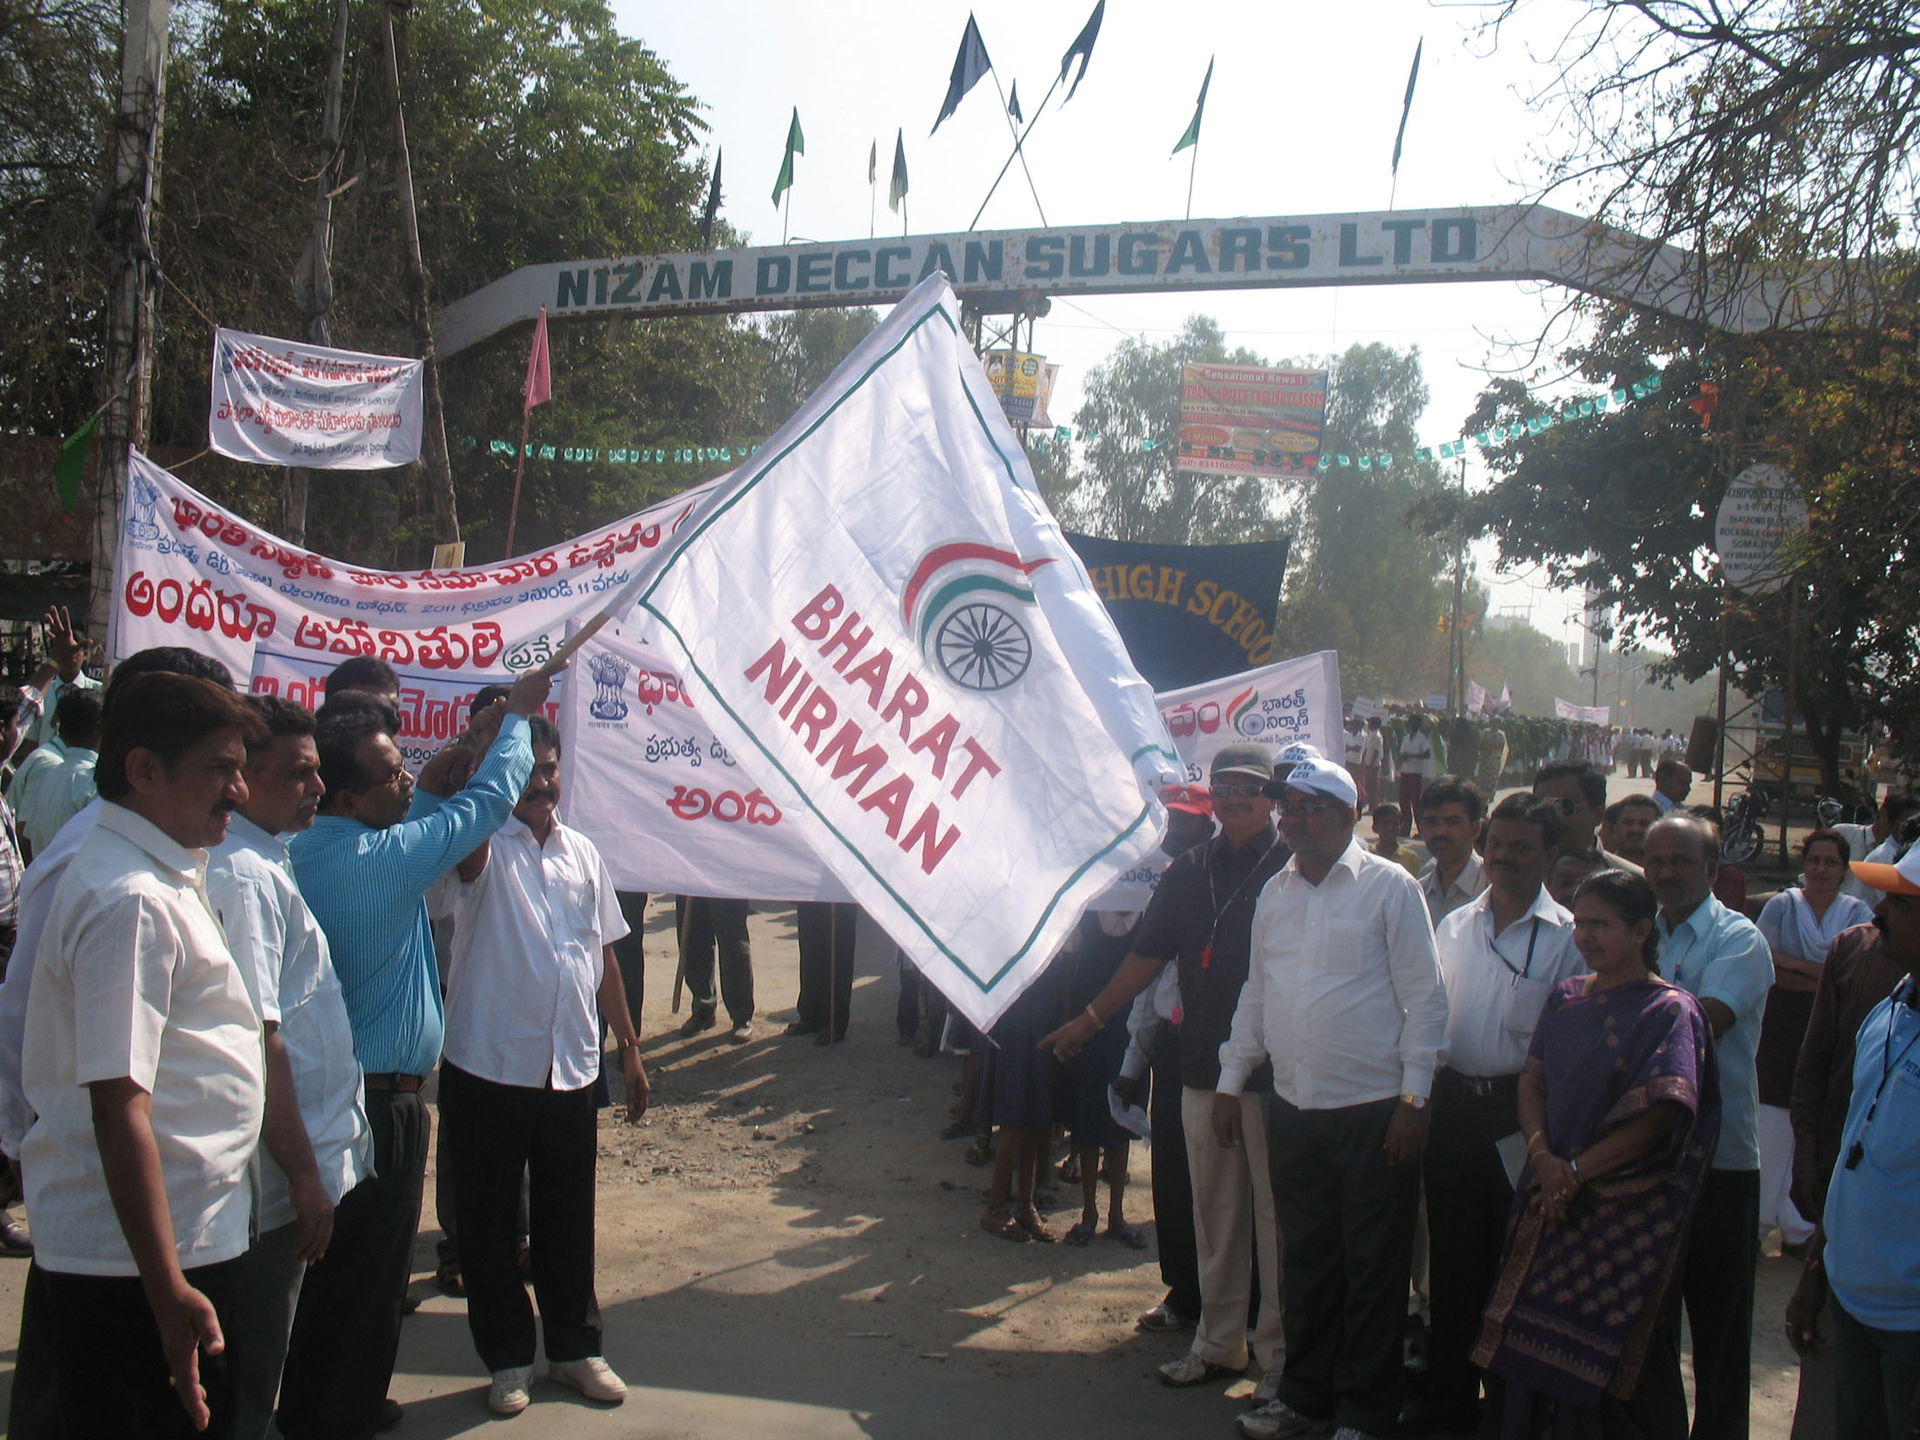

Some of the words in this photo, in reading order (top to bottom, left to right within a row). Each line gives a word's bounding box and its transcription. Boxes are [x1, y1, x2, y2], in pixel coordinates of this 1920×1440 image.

[557, 259, 733, 308] NIZAM
[755, 240, 1004, 297] DECCAN
[1024, 225, 1311, 279] SUGARS
[1338, 217, 1477, 268] LTD
[791, 583, 1002, 801] BHARAT
[1087, 563, 1188, 606] HIGH
[1186, 580, 1275, 665] SCHOO
[743, 637, 962, 875] NIRMAN
